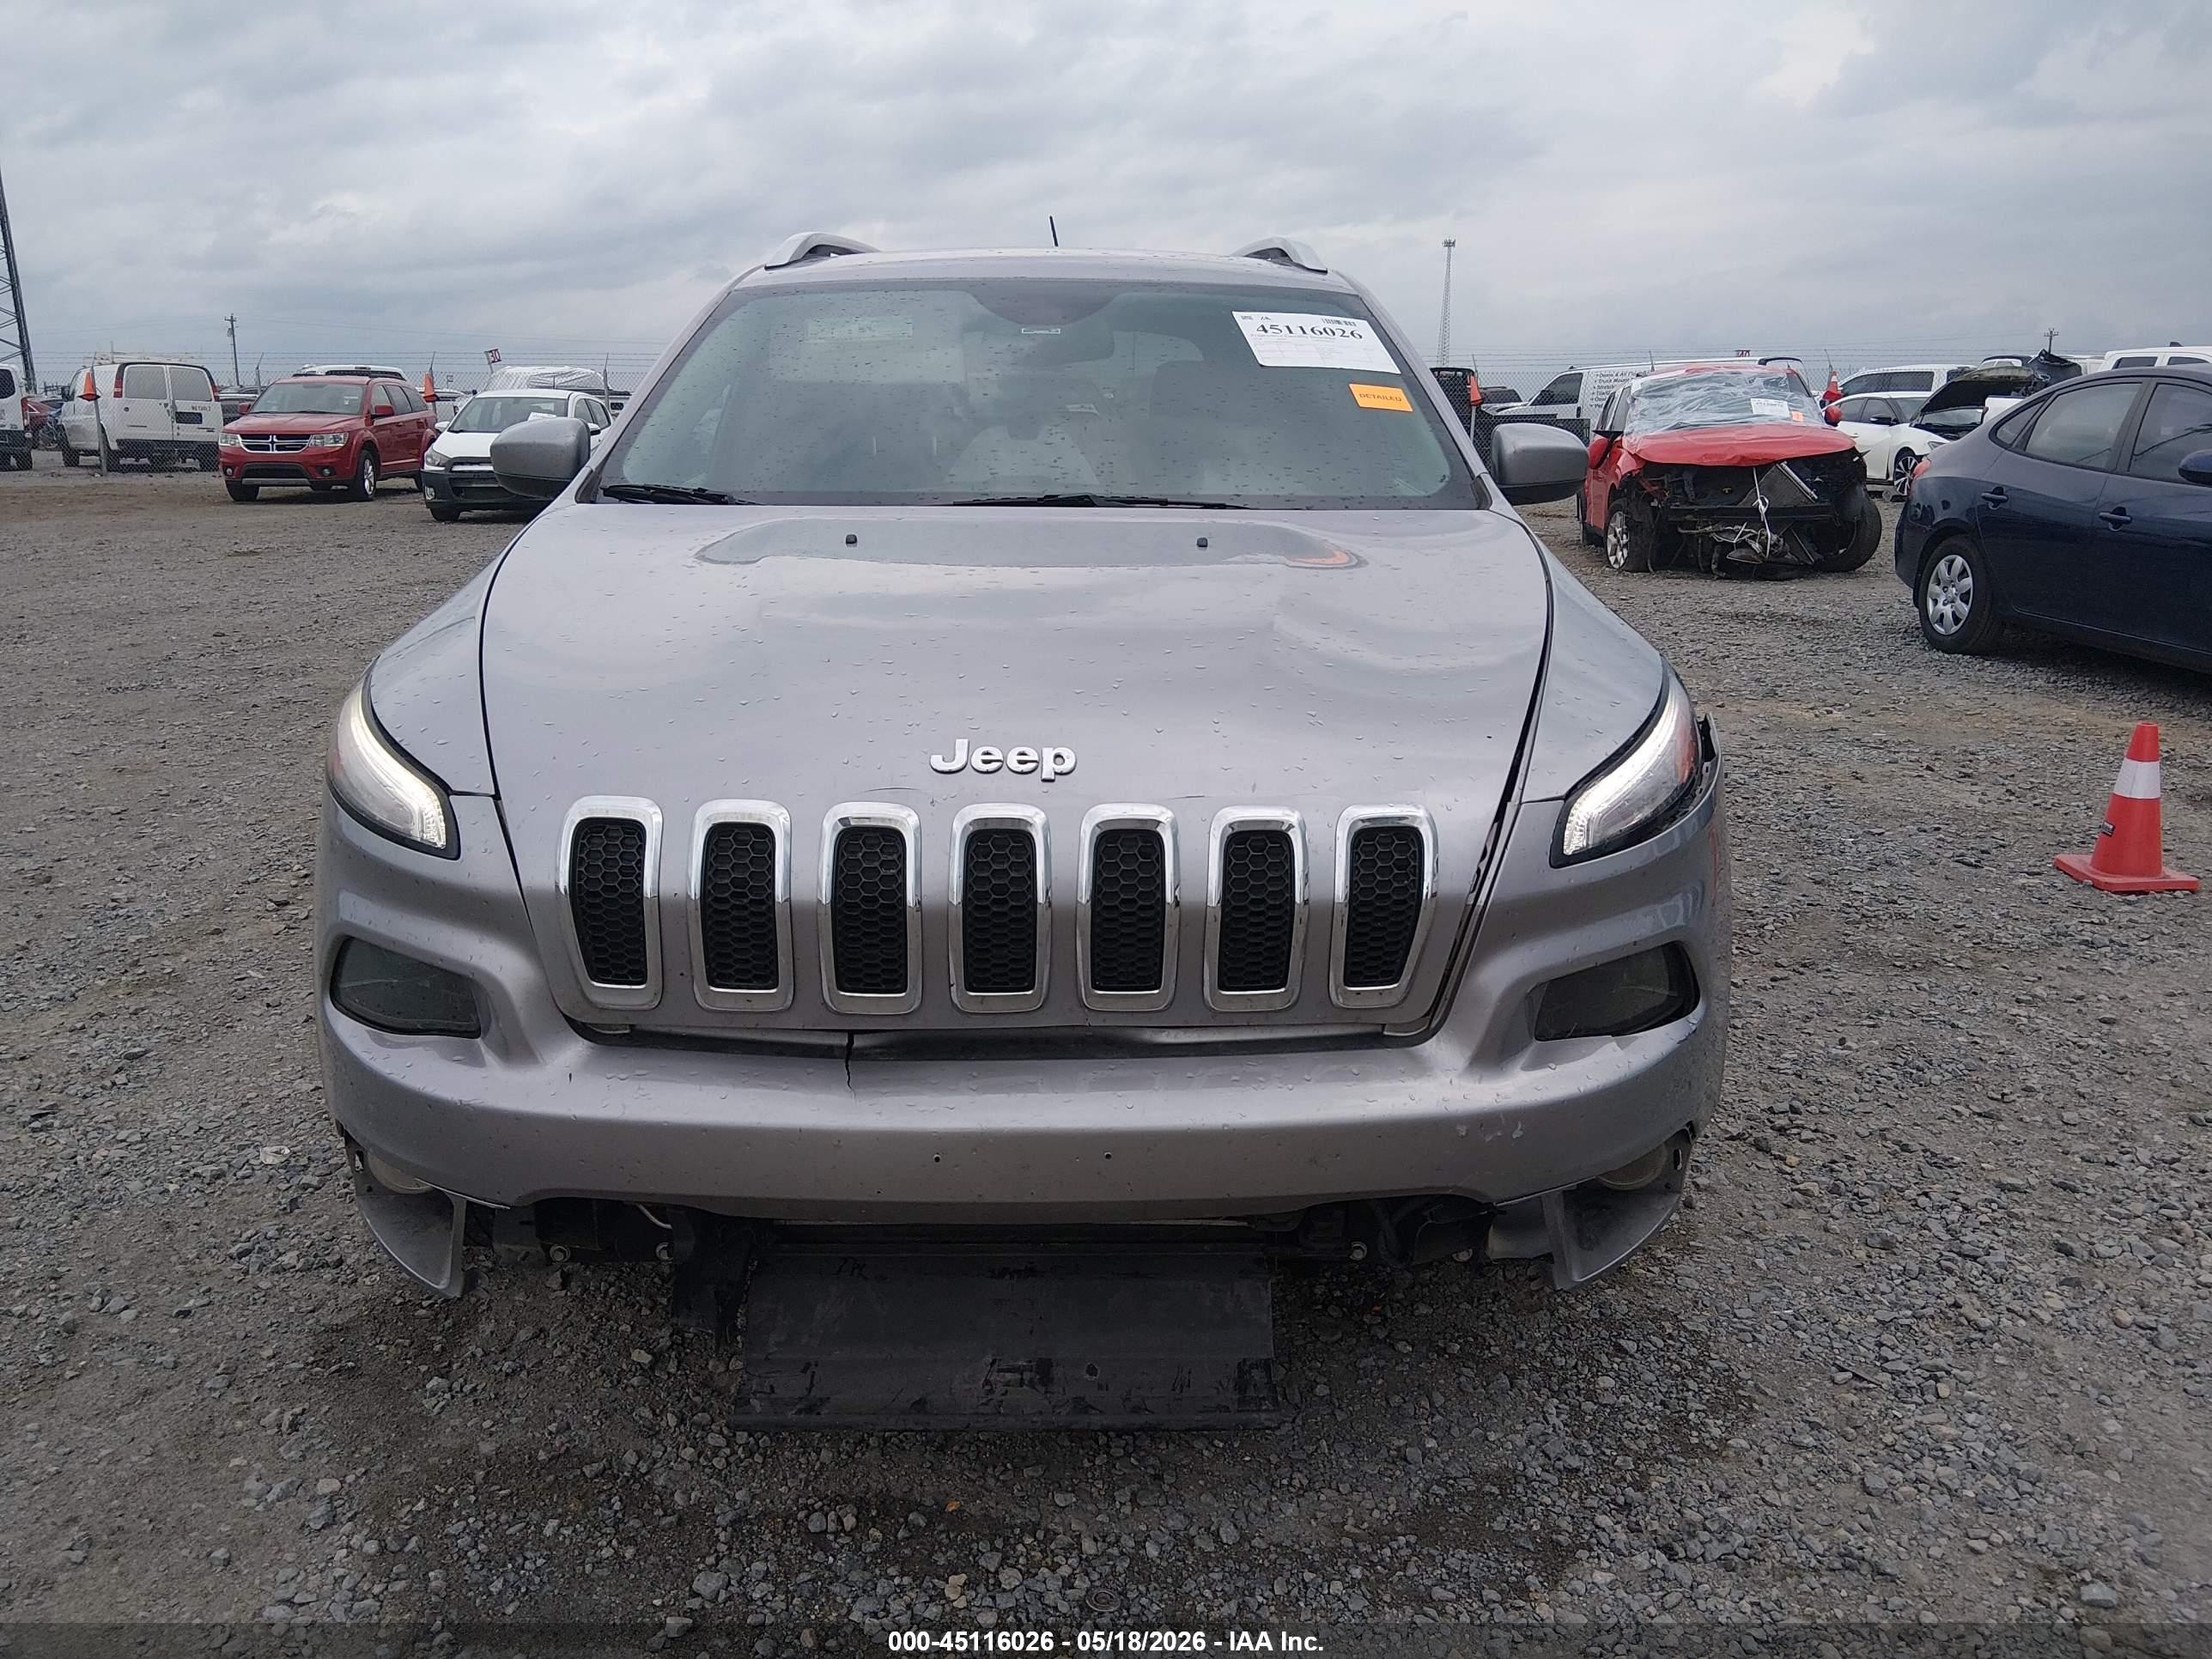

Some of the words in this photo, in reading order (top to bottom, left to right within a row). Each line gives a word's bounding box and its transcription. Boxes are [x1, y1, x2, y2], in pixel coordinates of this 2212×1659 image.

[1256, 324, 1363, 339] 45116026
[1358, 393, 1402, 402] DETAILED
[929, 738, 1077, 782] Jeep
